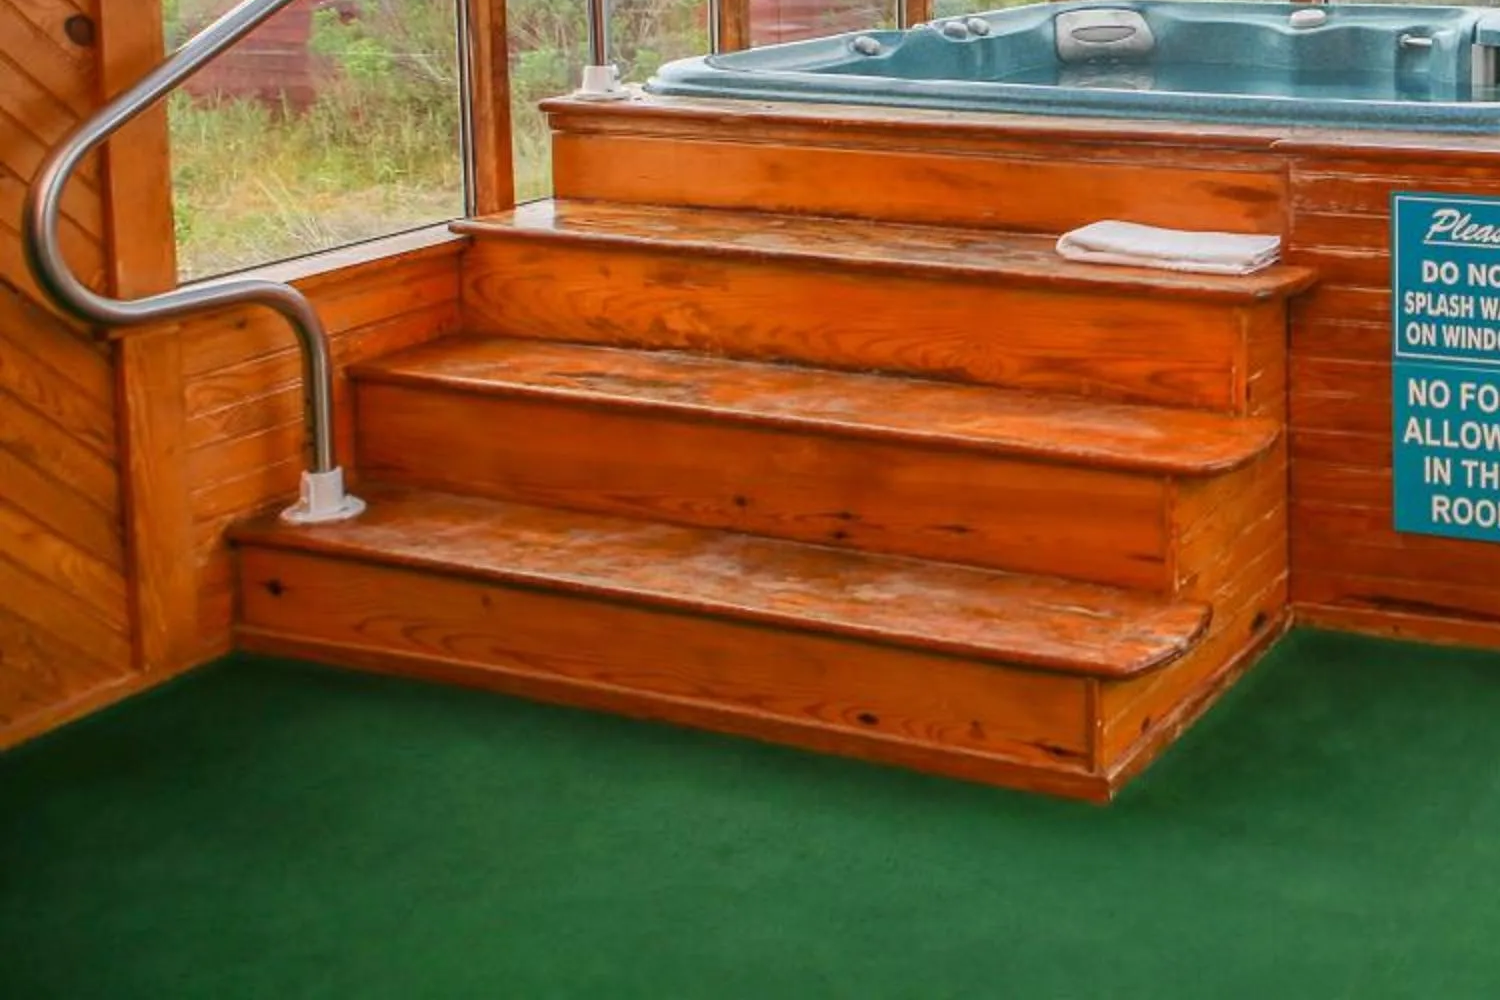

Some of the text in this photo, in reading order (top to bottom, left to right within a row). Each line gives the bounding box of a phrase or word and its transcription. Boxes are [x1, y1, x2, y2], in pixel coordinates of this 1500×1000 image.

[1421, 259, 1460, 286] DO
[1403, 291, 1475, 320] SPLASH
[1405, 321, 1437, 347] ON
[1407, 378, 1451, 409] NO
[1424, 456, 1452, 487] IN
